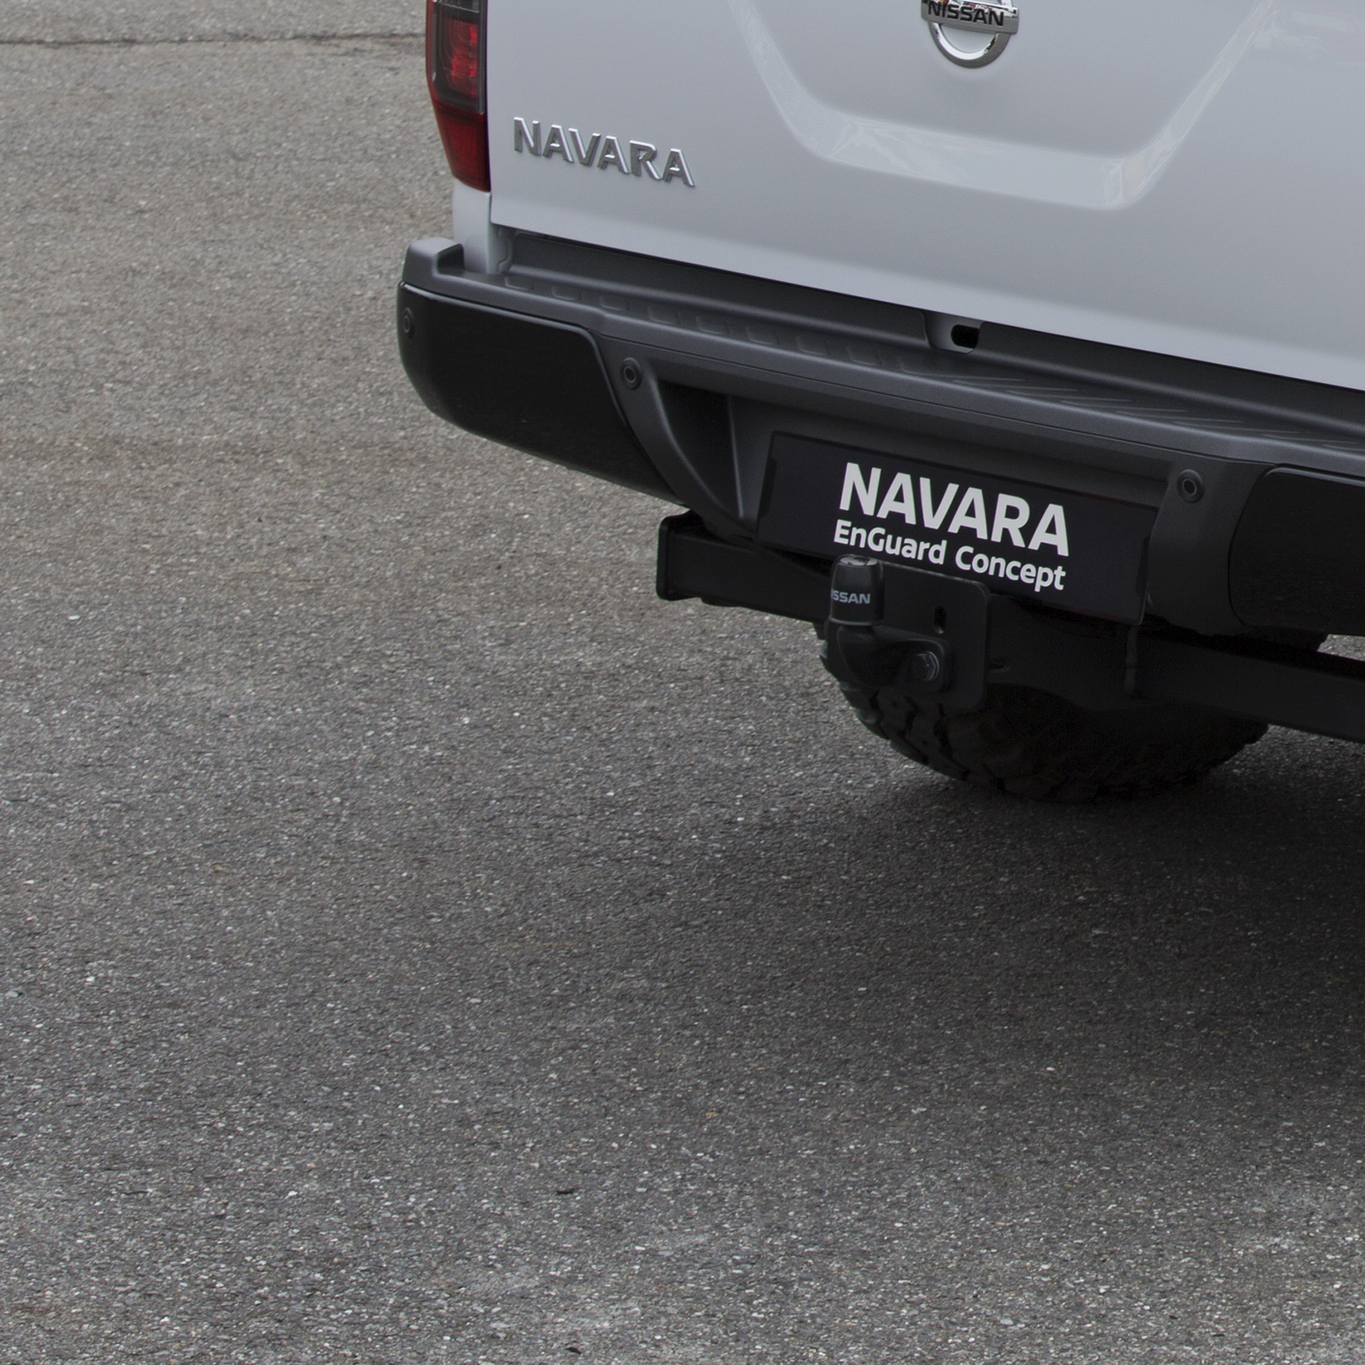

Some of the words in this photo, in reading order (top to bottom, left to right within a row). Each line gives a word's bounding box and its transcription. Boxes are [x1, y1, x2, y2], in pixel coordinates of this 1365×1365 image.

[927, 0, 1005, 27] NISSAN
[513, 116, 696, 188] NAVARA
[839, 462, 1070, 557] NAVARA
[833, 519, 948, 565] EnGuard
[954, 545, 1067, 592] Concept
[830, 588, 872, 605] ISSAN
